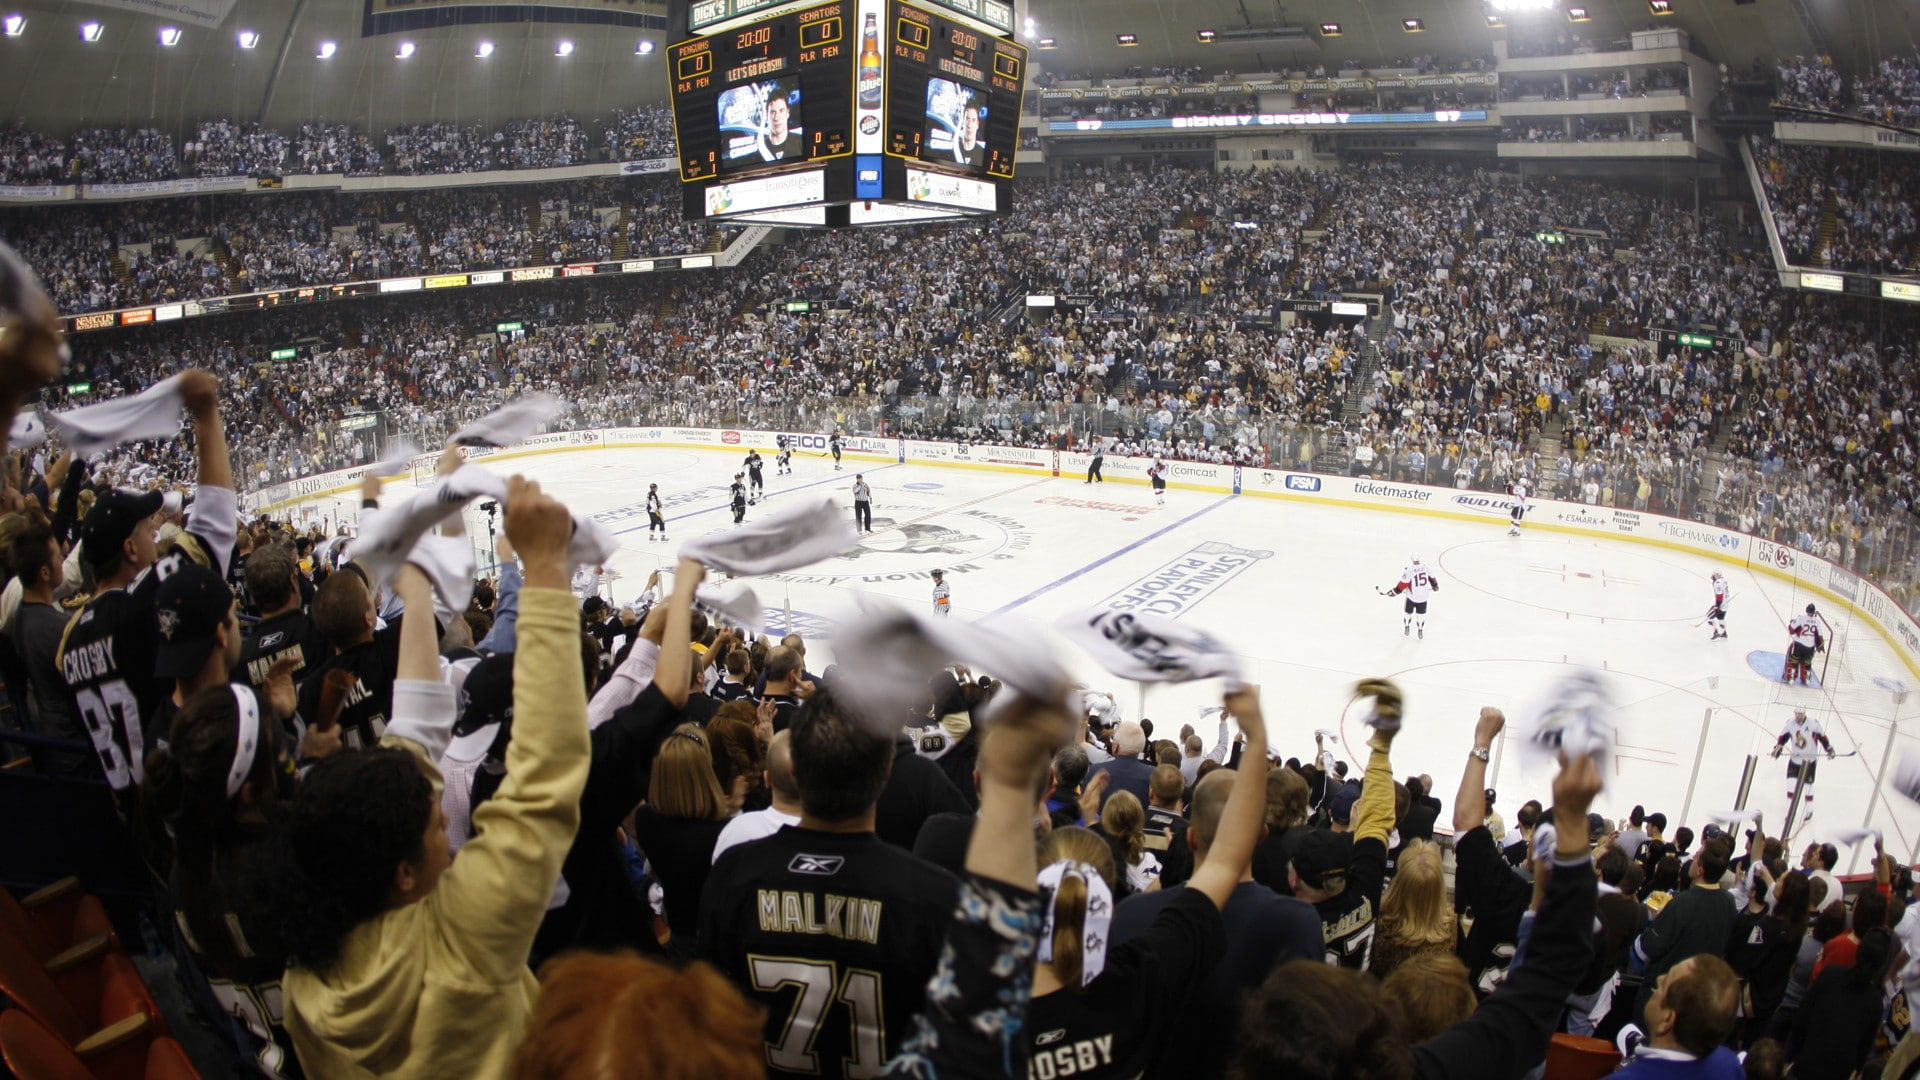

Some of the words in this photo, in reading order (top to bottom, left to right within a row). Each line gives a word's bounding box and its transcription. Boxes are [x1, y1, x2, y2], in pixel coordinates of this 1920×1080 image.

[179, 5, 218, 21] Company
[693, 1, 725, 22] DICK'S
[799, 6, 841, 23] SENATORS
[901, 6, 930, 24] PENGUINS
[985, 2, 1009, 23] DICK'S
[737, 27, 771, 49] 20:00
[822, 22, 831, 39] 0
[914, 27, 922, 43] 0
[951, 29, 977, 51] 20:00
[679, 41, 710, 57] PENGUINS
[800, 51, 816, 63] PLR
[822, 46, 839, 58] PEN
[895, 45, 909, 58] PLR
[912, 49, 926, 63] PEN
[696, 56, 703, 71] 0
[1007, 60, 1014, 74] 0
[728, 66, 747, 81] LET'S
[748, 64, 758, 77] GO
[678, 82, 691, 93] PLR
[696, 76, 710, 89] PEN
[860, 77, 881, 93] Blue
[1340, 81, 1364, 89] FRANCIS
[1172, 115, 1253, 128] SIDNEY
[1259, 112, 1350, 125] CROSBY
[726, 249, 740, 264] HAVE
[563, 267, 581, 277] TRIB
[525, 436, 567, 445] DODGE
[861, 439, 886, 451] CLARK
[957, 444, 969, 455] 68
[1068, 458, 1088, 466] UPMC
[1112, 461, 1141, 471] Medicine
[1171, 464, 1217, 478] comcast
[292, 479, 321, 495] TRIB
[1290, 476, 1316, 490] FSN
[1354, 481, 1432, 501] ticketmaster
[1457, 496, 1489, 508] BUD
[1491, 500, 1536, 513] LIGT
[1565, 514, 1599, 526] ESMARK
[1612, 518, 1641, 527] Pittsburgh
[1614, 511, 1640, 520] Wheeling
[1664, 523, 1719, 546] HIGHMARK
[1758, 541, 1775, 553] IT'S
[1758, 552, 1772, 563] ON
[1800, 558, 1828, 580] CIBC
[1108, 558, 1207, 611] PLAYOFFS
[1168, 555, 1247, 602] STANLEY
[1413, 572, 1428, 587] 15
[1830, 570, 1859, 597] Mellon
[1861, 582, 1884, 620] TRIB
[1802, 624, 1816, 637] 29
[1897, 618, 1919, 648] verizon
[63, 637, 118, 685] CROSBY
[76, 679, 145, 791] 87
[757, 889, 882, 945] MALKIN
[747, 953, 887, 1080] 71
